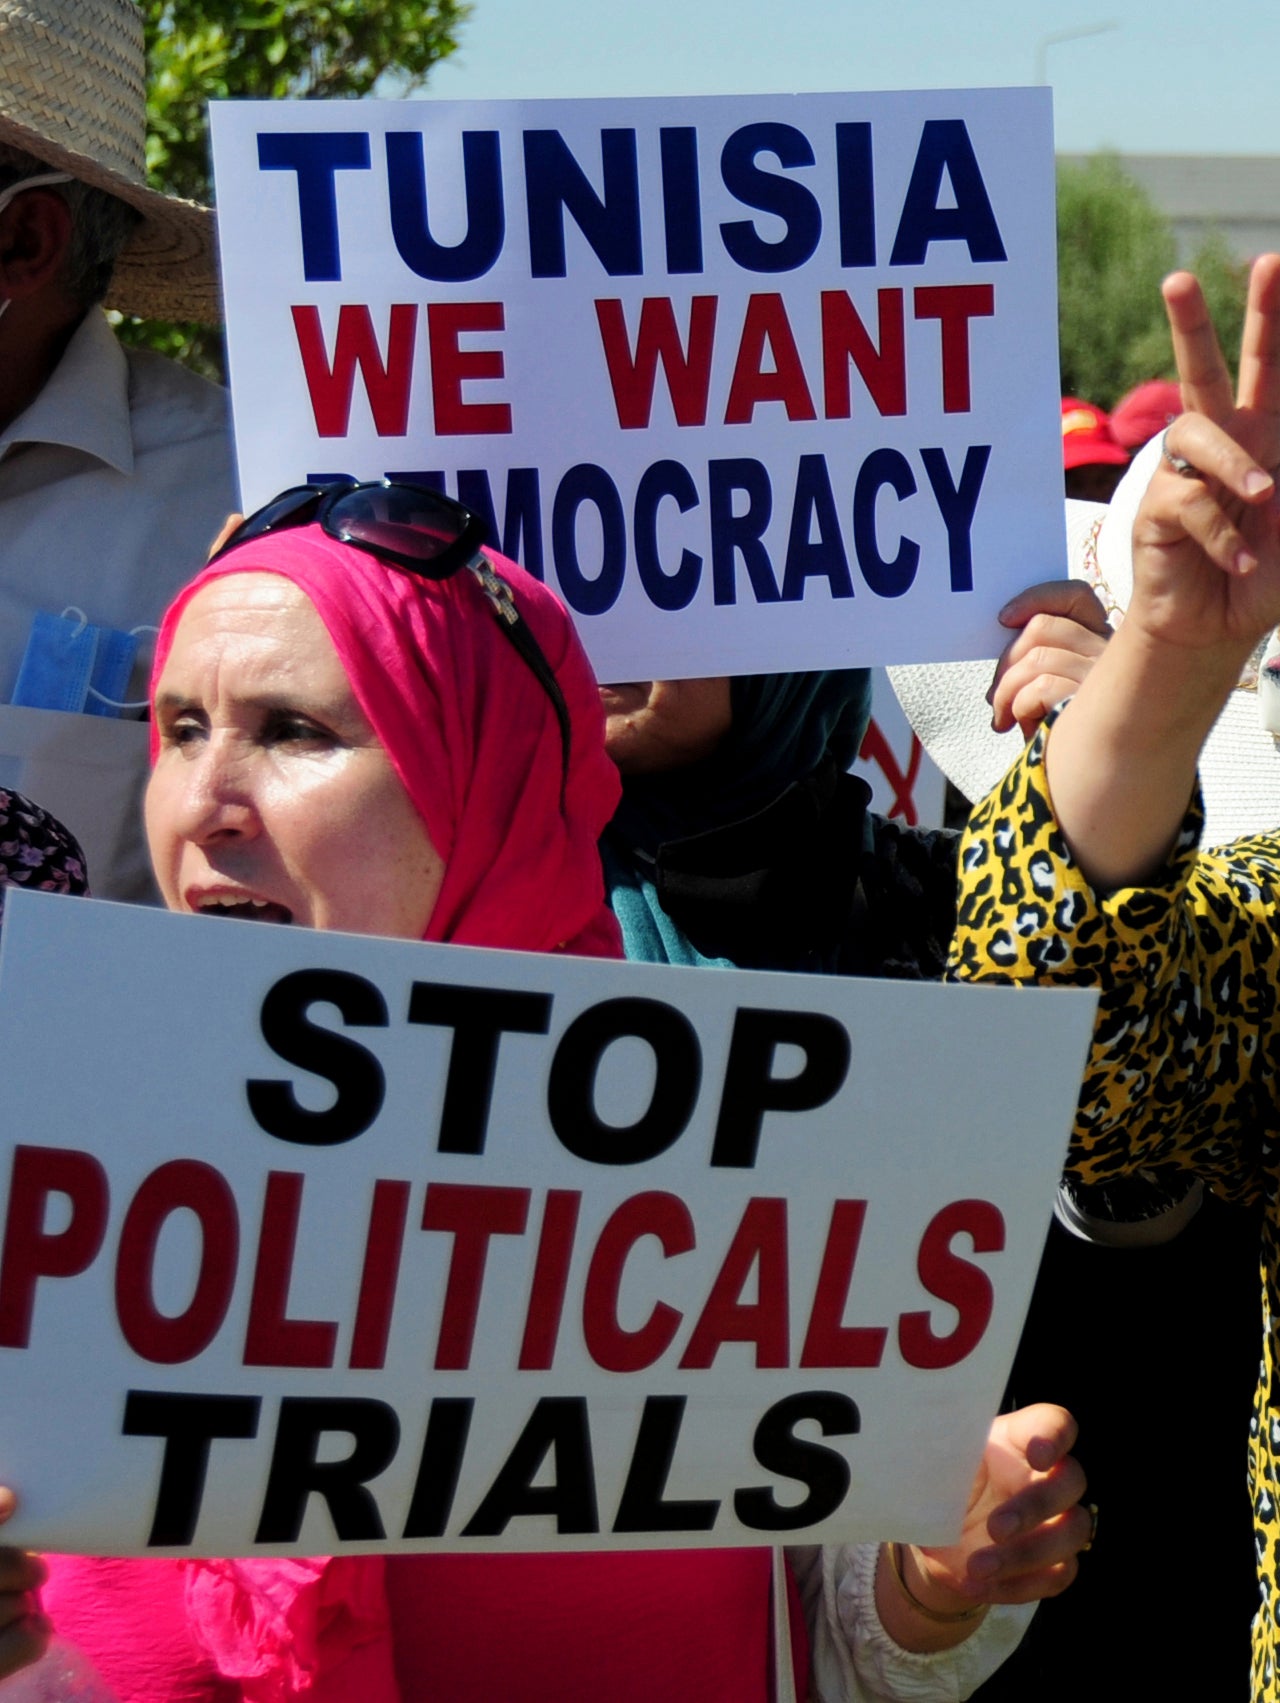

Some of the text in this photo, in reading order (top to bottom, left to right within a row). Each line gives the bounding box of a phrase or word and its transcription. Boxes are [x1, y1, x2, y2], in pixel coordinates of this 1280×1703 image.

[257, 119, 1008, 282] TUNISIA
[290, 285, 995, 438] WE WANT
[306, 445, 992, 616] MOCRACY
[245, 967, 852, 1168] STOP
[0, 1144, 1006, 1373] POLITICALS
[121, 1389, 862, 1547] TRIALS
